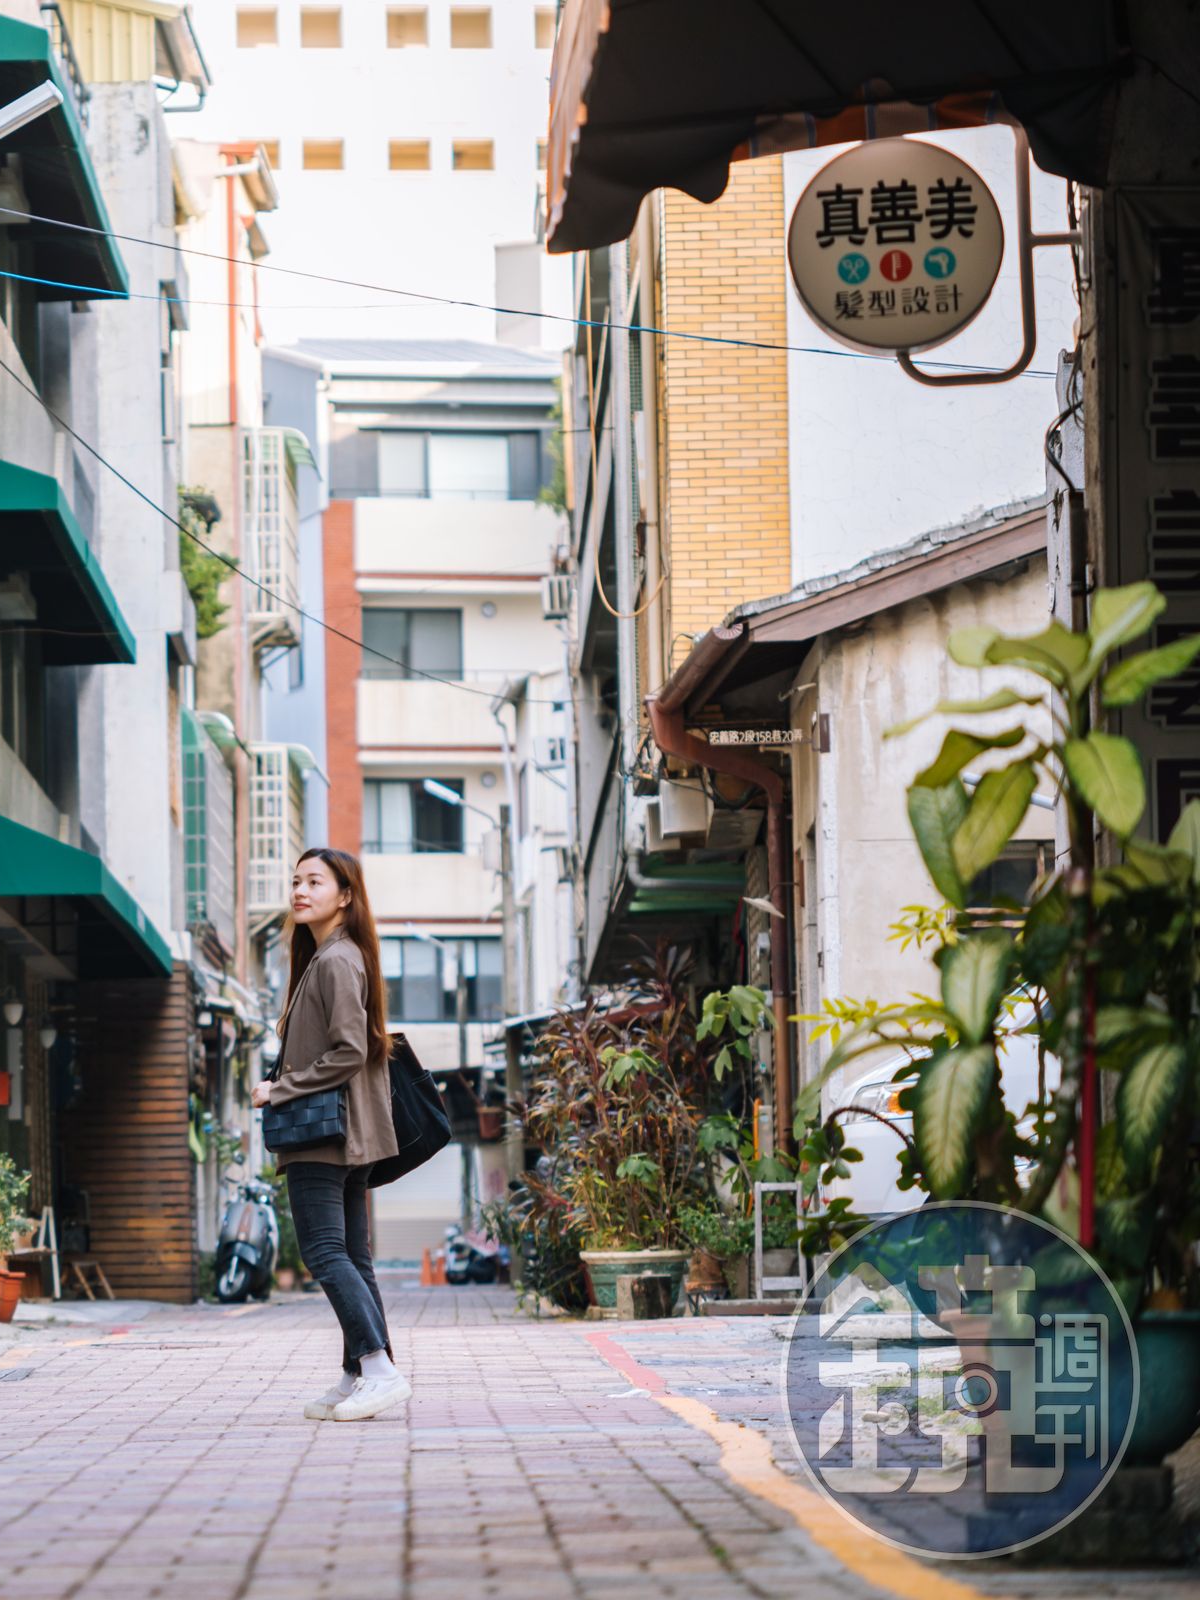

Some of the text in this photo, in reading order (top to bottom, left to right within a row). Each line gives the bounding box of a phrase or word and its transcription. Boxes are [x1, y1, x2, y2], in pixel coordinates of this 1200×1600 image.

[816, 177, 978, 248] 真善美
[834, 285, 964, 320] 髮型設計
